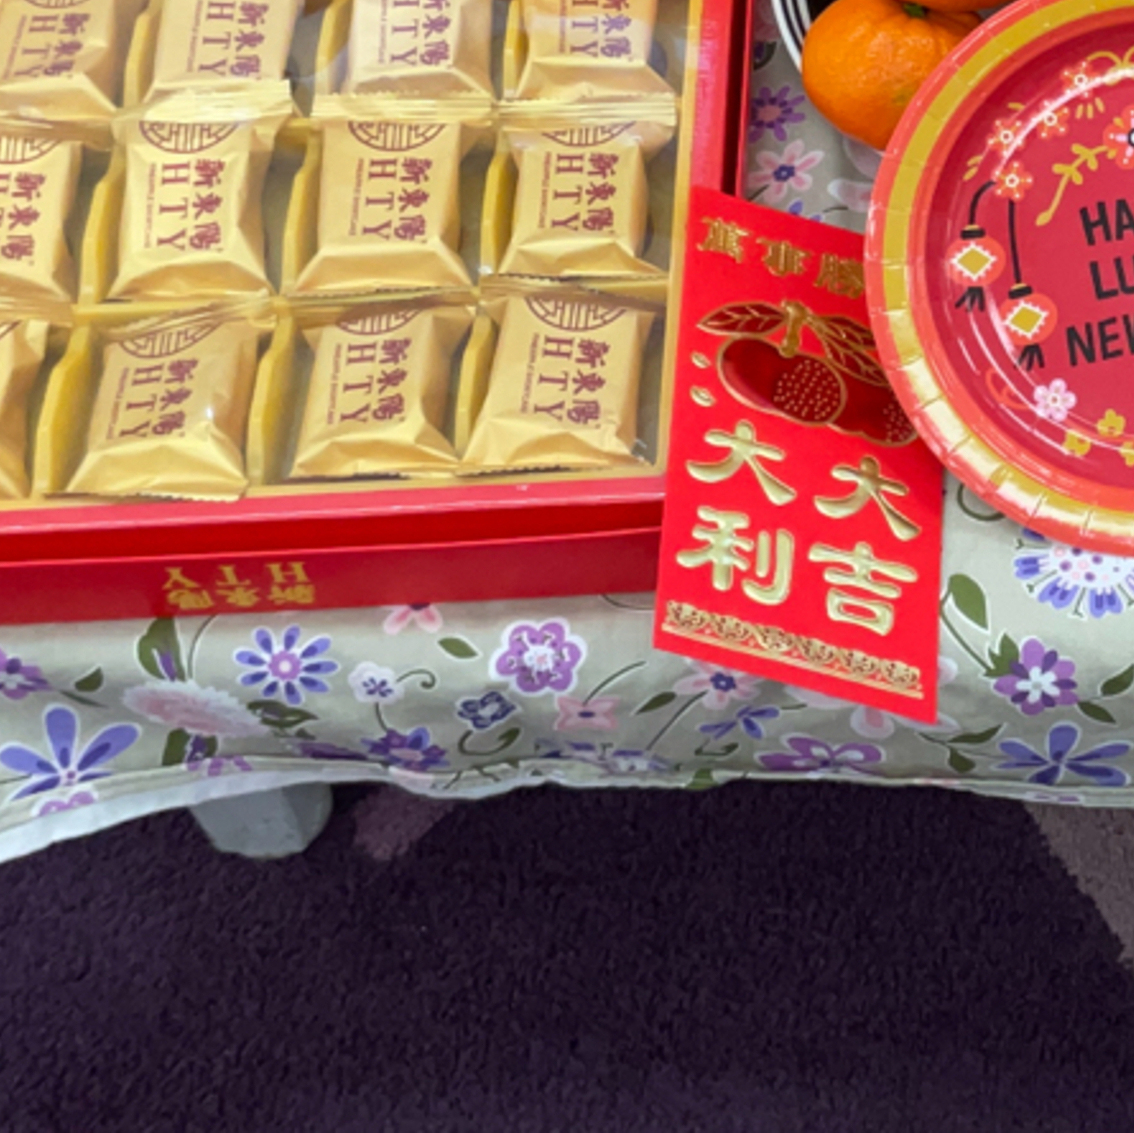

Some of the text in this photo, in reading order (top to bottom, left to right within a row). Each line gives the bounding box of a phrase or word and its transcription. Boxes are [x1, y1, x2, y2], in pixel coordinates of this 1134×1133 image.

[14, 15, 60, 78] HTY
[198, 2, 236, 76] HTY
[157, 162, 190, 251] HTY
[362, 158, 398, 240] HTY
[551, 153, 585, 232] HTY
[119, 365, 163, 438] HTY
[339, 341, 378, 423] HTY
[533, 336, 574, 421] HTY
[165, 561, 311, 589] HTY
